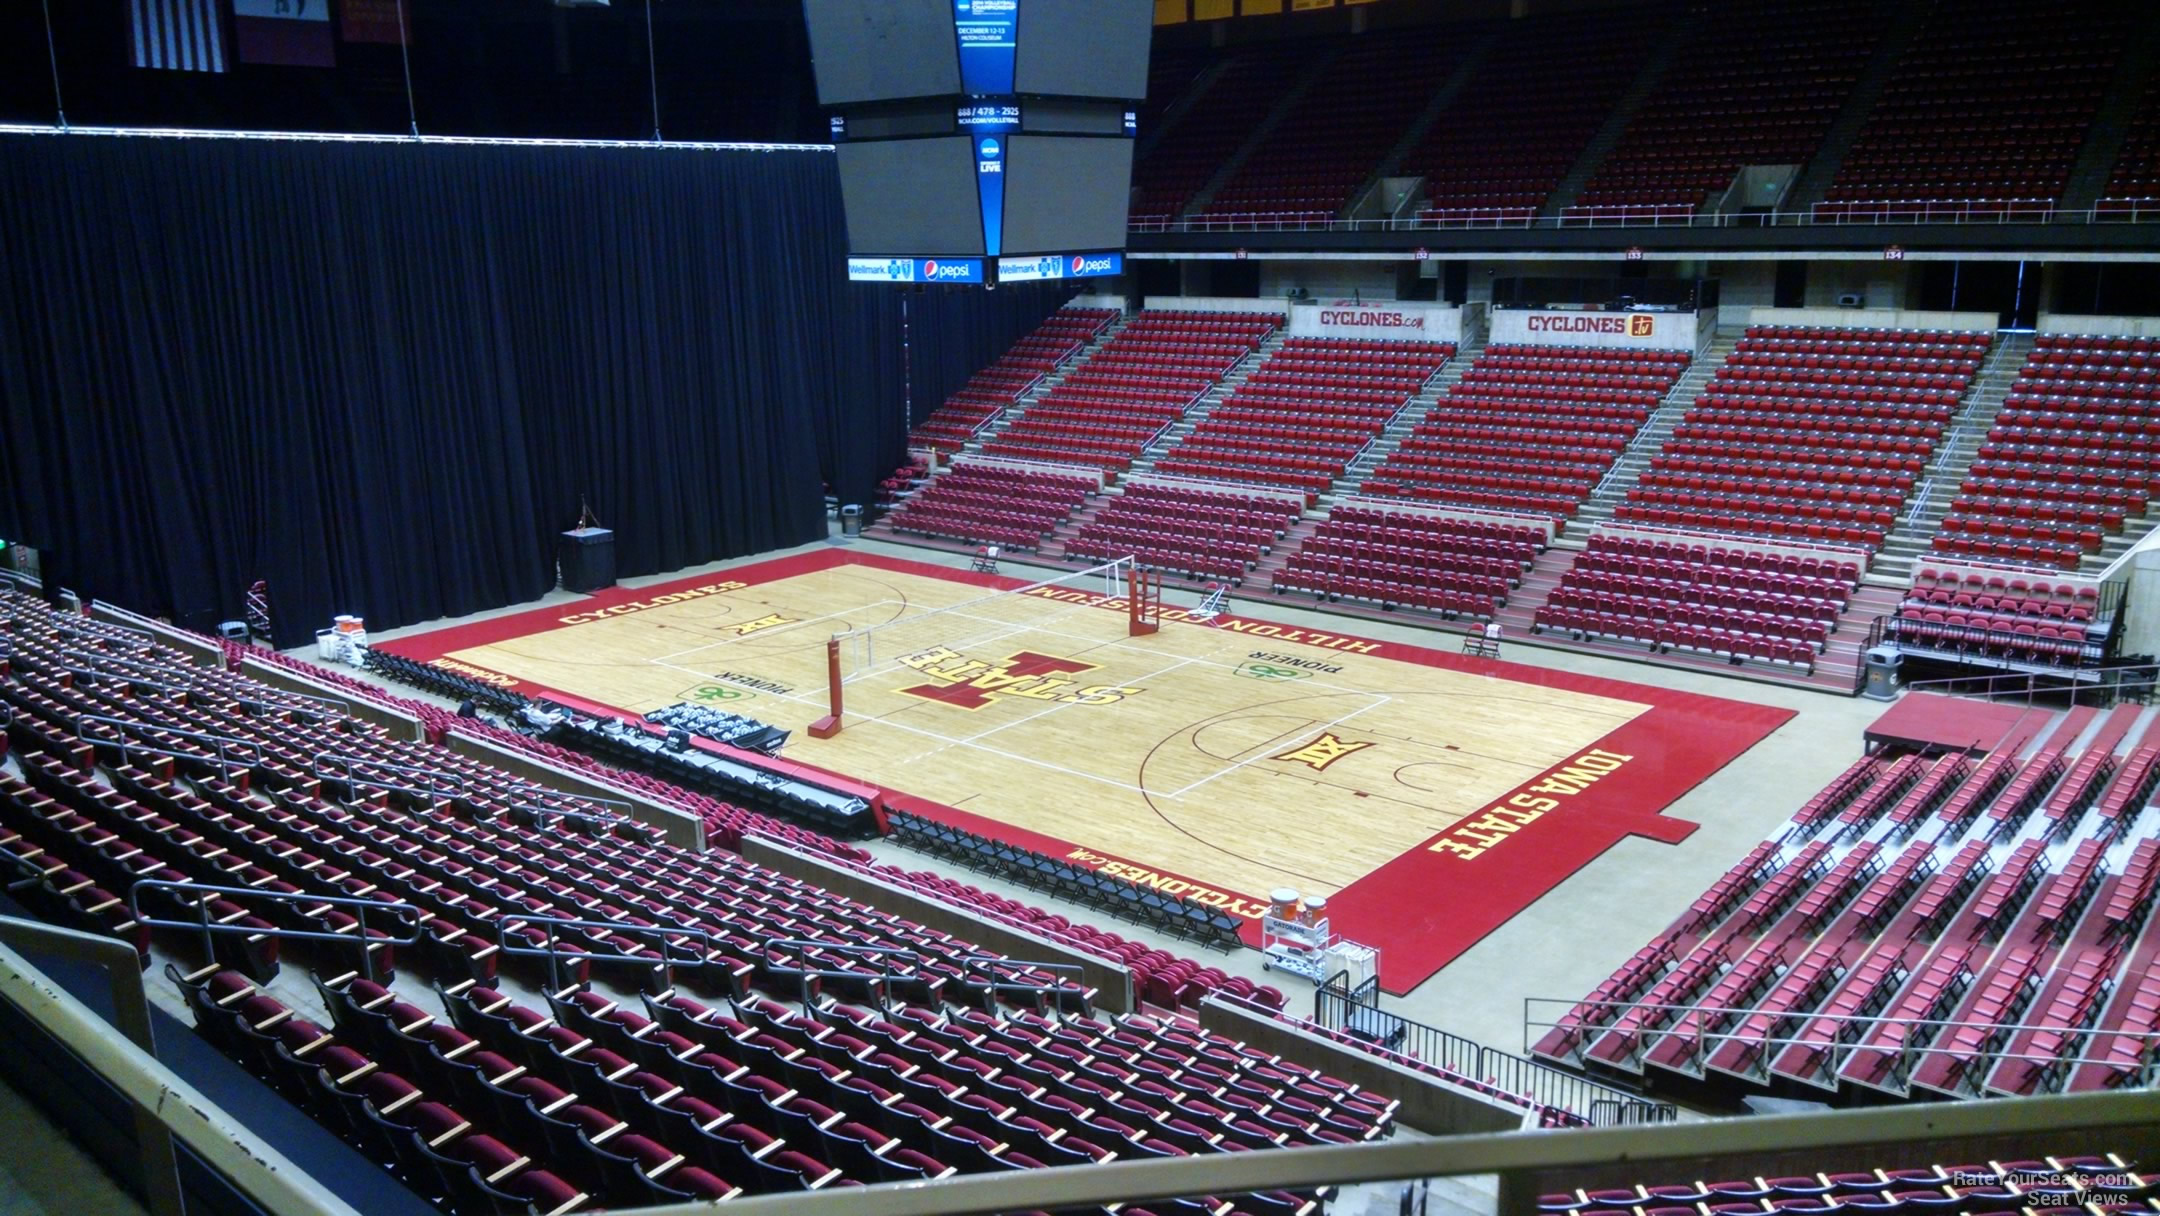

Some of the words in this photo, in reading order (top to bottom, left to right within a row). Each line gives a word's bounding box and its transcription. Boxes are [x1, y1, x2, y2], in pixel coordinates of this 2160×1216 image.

[977, 107, 995, 116] 478
[1001, 106, 1019, 116] 2925
[980, 164, 1001, 173] LIVE
[939, 263, 969, 279] pepsi
[1085, 257, 1111, 273] pepsi
[1528, 315, 1625, 334] CYCLONES
[557, 580, 748, 625] CYCLONES
[1218, 614, 1383, 655] HILTON
[895, 644, 1148, 706] STATE
[1247, 650, 1344, 675] PIONEER
[714, 671, 794, 696] PIONEER
[1528, 748, 1634, 796] IOWA
[1427, 793, 1560, 861] STATE
[1273, 920, 1305, 935] GATORADE
